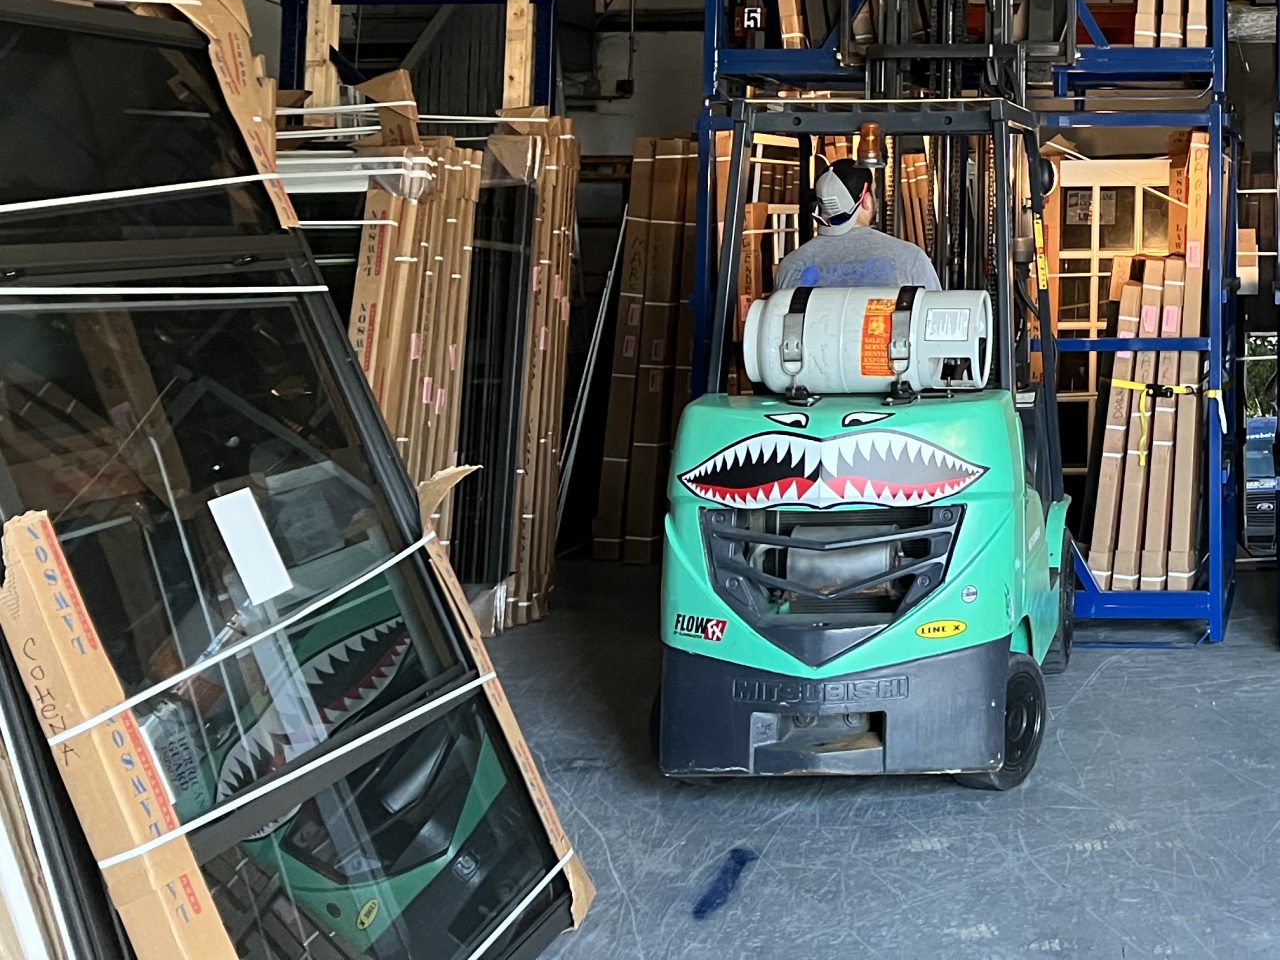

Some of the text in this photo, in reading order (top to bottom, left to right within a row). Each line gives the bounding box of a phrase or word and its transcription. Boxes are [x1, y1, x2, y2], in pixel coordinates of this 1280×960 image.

[26, 524, 88, 656] LAWSON
[675, 613, 708, 635] FLOW
[921, 622, 961, 635] LINE X
[733, 676, 909, 704] MITSUBISHI
